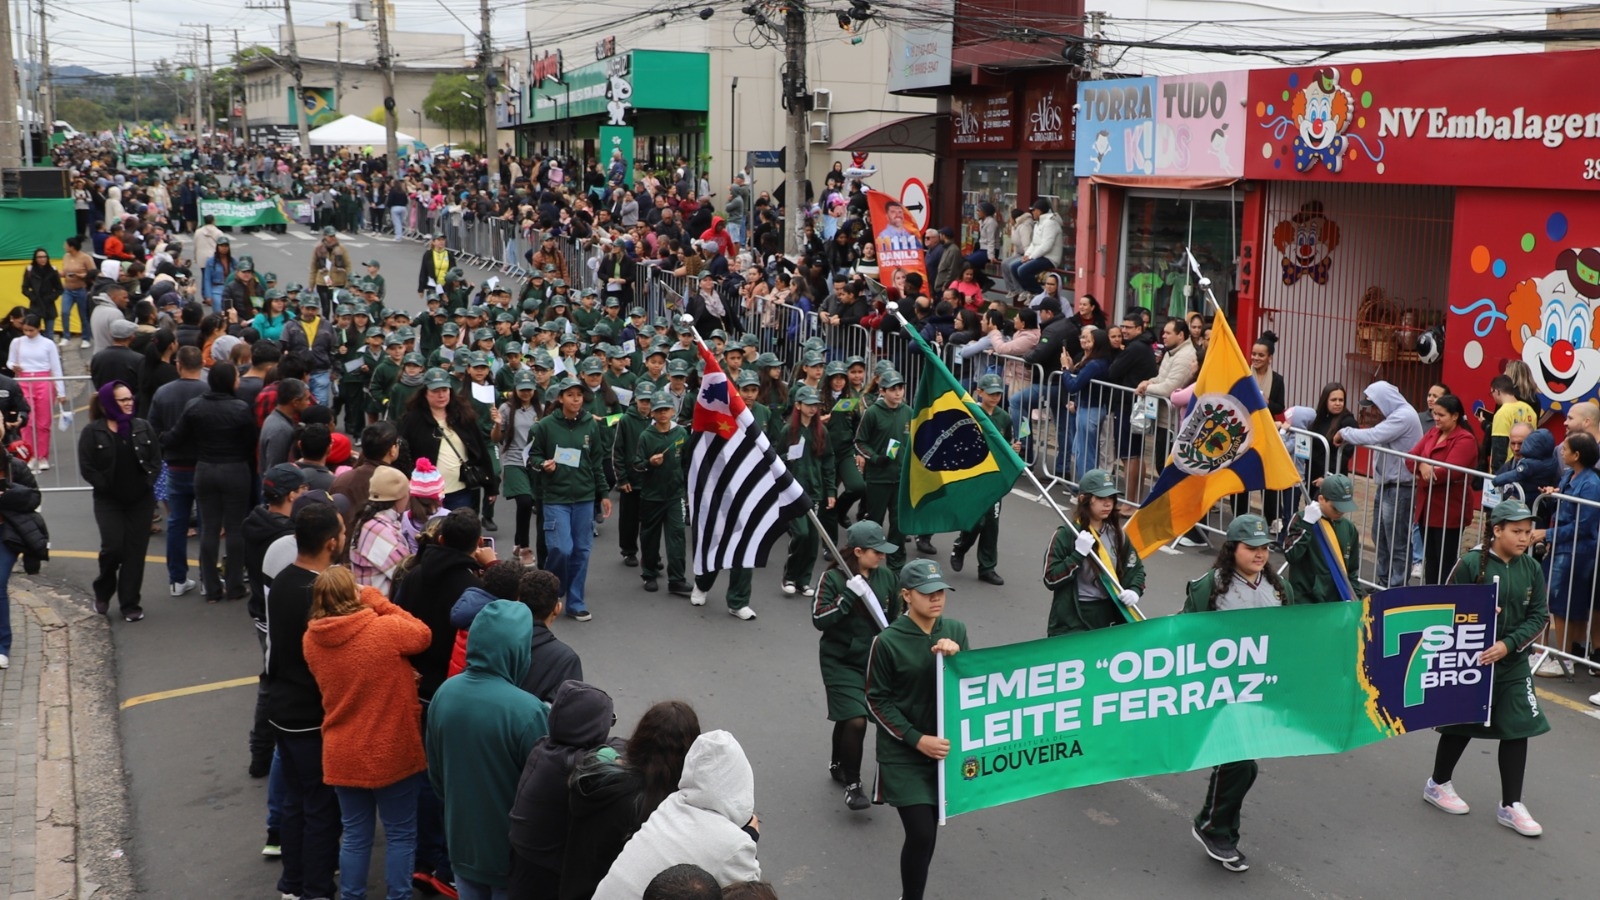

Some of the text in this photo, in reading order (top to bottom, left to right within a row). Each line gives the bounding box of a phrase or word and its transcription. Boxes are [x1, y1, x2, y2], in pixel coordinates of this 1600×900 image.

[1084, 80, 1227, 122] TORRA TUDO
[1378, 107, 1425, 137] NV
[880, 250, 918, 260] DANILO
[1455, 613, 1478, 623] DE
[1421, 624, 1486, 651] SE
[1383, 604, 1456, 707] 7
[1421, 651, 1483, 670] TEM
[959, 635, 1269, 710] EMEB “ODILON
[1420, 669, 1482, 689] BRO
[1526, 676, 1539, 718] OUVEIRA
[960, 673, 1278, 752] LEITE FERRAZ”
[981, 739, 1084, 776] LOUVEIRA
[997, 734, 1063, 751] PREFEITURA DE
